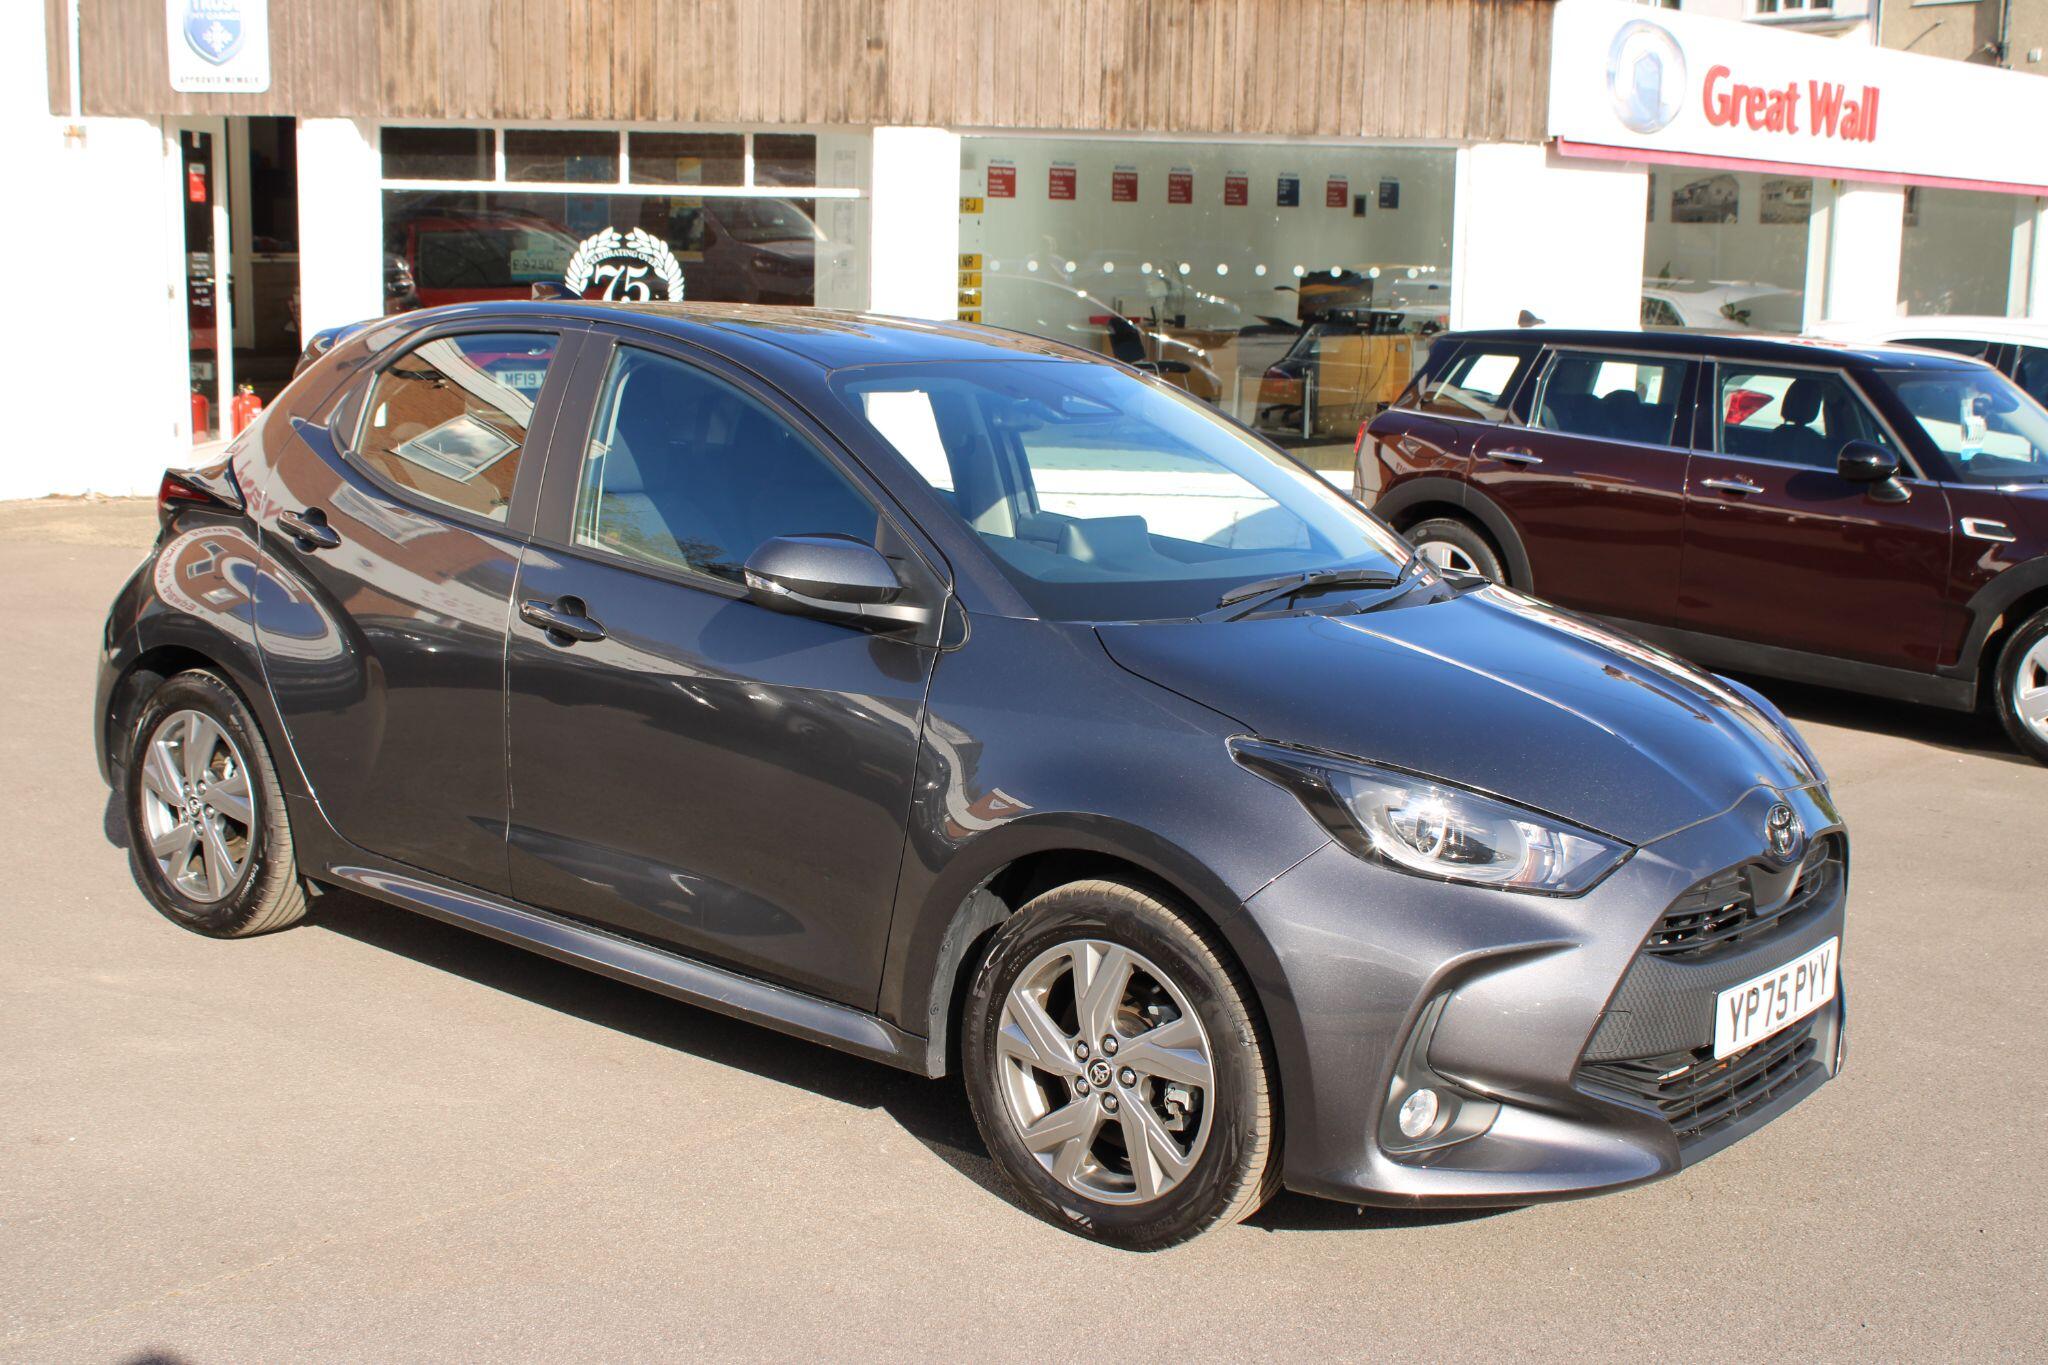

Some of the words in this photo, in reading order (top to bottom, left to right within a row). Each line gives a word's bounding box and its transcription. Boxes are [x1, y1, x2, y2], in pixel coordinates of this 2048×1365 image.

[1703, 64, 1801, 135] Great
[1808, 79, 1880, 143] Wall
[594, 264, 650, 302] 75
[505, 372, 536, 386] MF19
[1730, 972, 1789, 1042] YP75
[1794, 949, 1830, 1012] PYY
